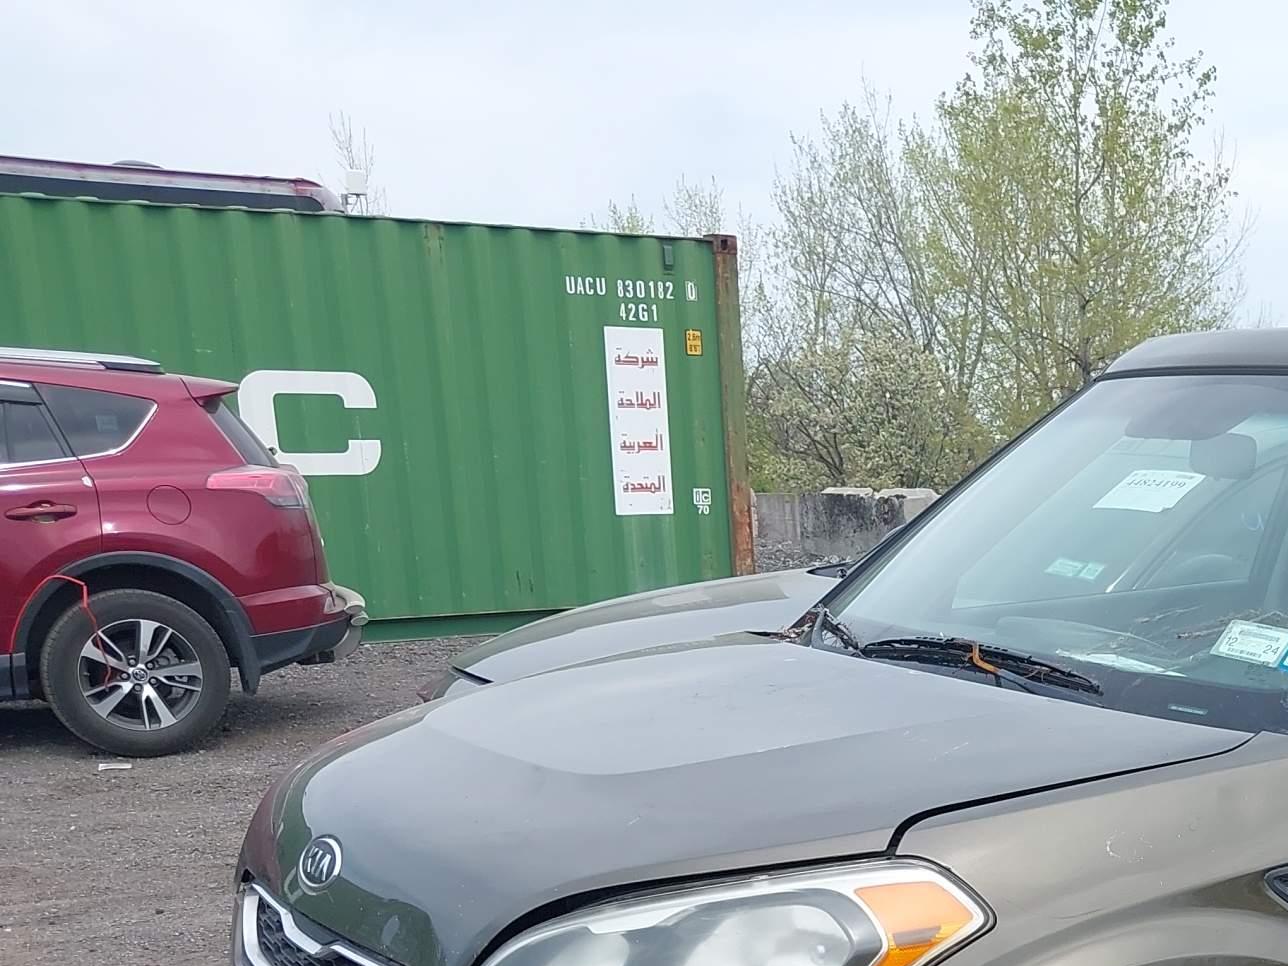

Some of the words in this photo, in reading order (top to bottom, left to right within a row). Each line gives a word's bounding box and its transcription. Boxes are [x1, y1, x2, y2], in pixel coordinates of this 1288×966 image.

[565, 276, 606, 295] UACU
[617, 279, 675, 299] 830182
[619, 303, 658, 321] 42G1
[614, 347, 659, 369] شركة
[617, 390, 661, 410] الملاحة
[238, 370, 382, 475] C
[620, 430, 663, 454] العربية
[622, 474, 666, 494] المتحدة
[697, 505, 710, 515] 70
[1224, 635, 1239, 647] 12
[1262, 644, 1281, 656] 24
[303, 845, 332, 881] KIA
